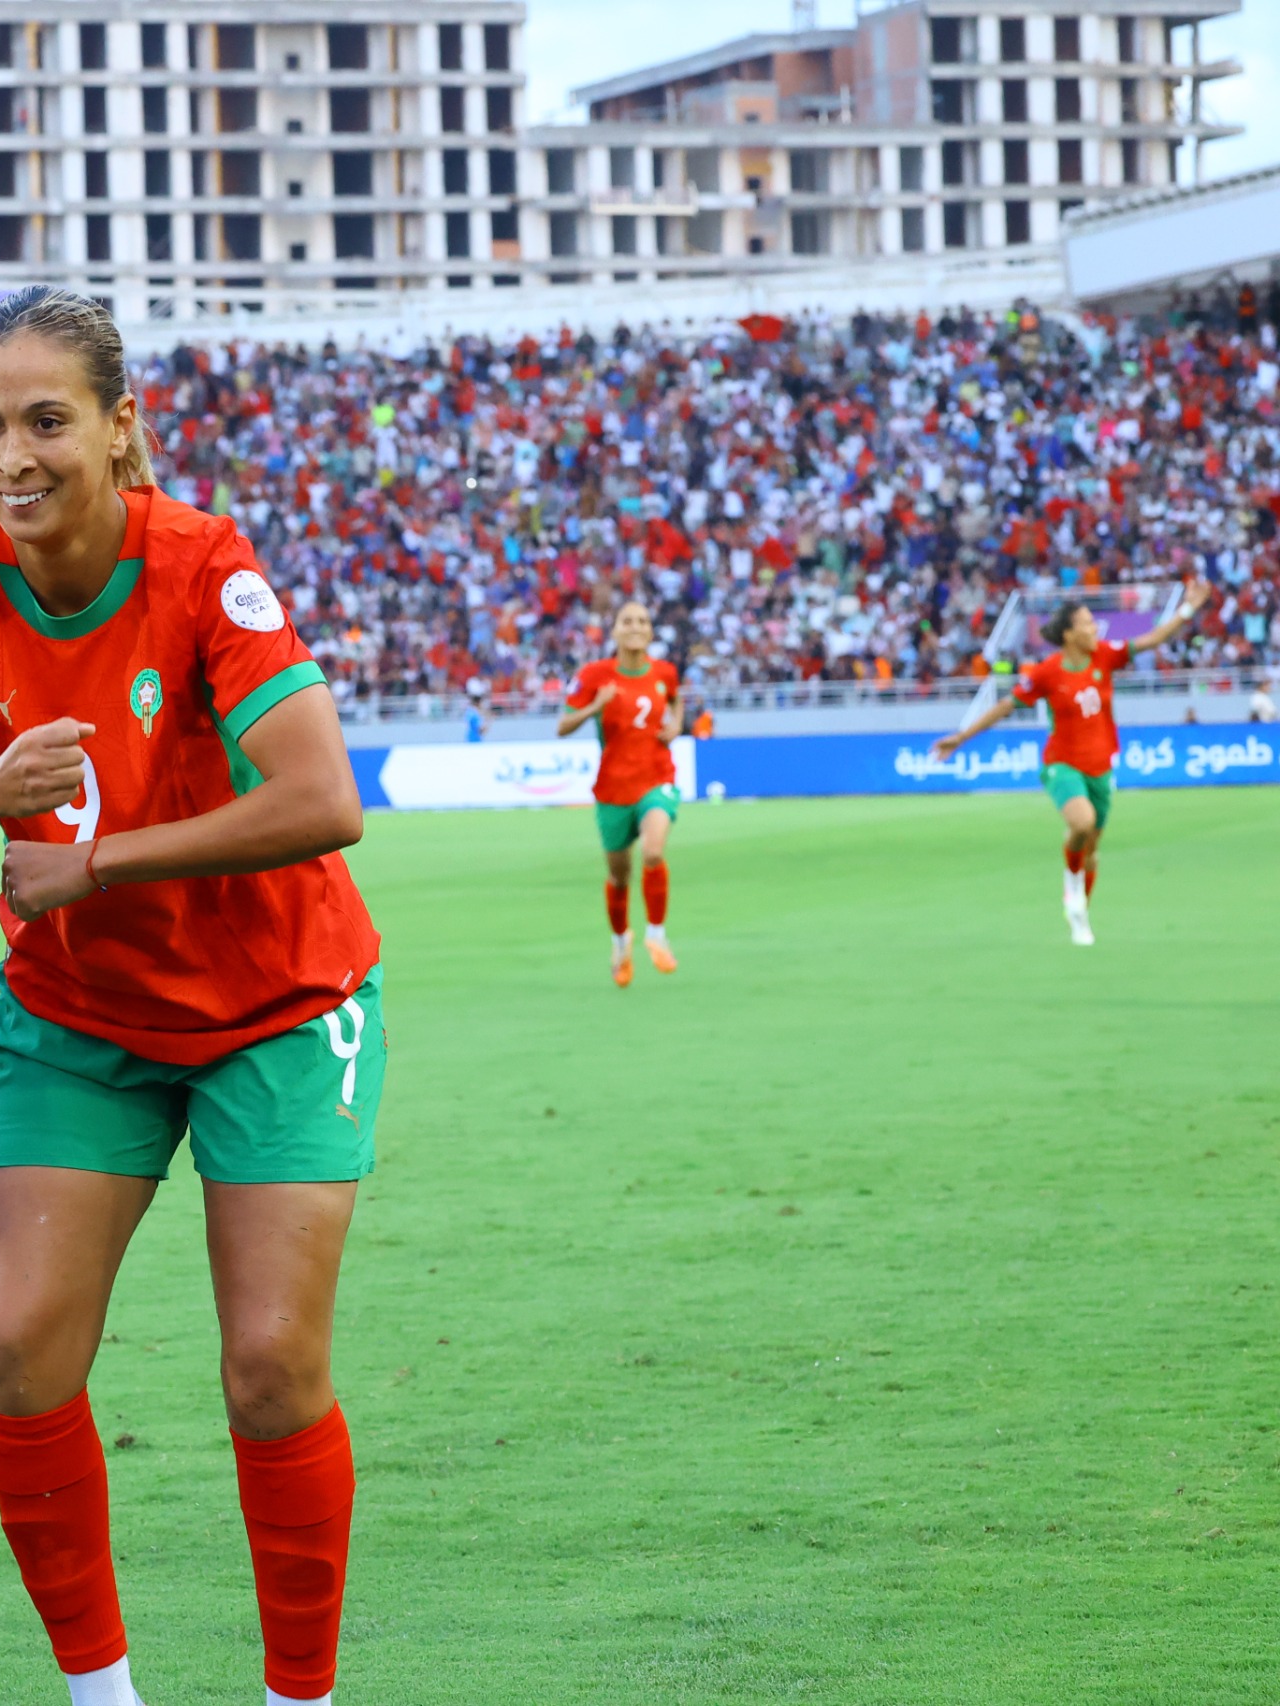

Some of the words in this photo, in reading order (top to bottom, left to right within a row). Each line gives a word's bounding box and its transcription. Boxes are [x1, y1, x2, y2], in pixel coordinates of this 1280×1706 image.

[235, 590, 269, 607] Celebrate
[251, 605, 270, 614] CAF
[633, 695, 652, 729] 2
[1074, 686, 1101, 718] 10
[1124, 736, 1176, 776] كرة
[1184, 734, 1274, 778] طموح
[54, 751, 101, 844] 9
[323, 997, 365, 1105] 9
